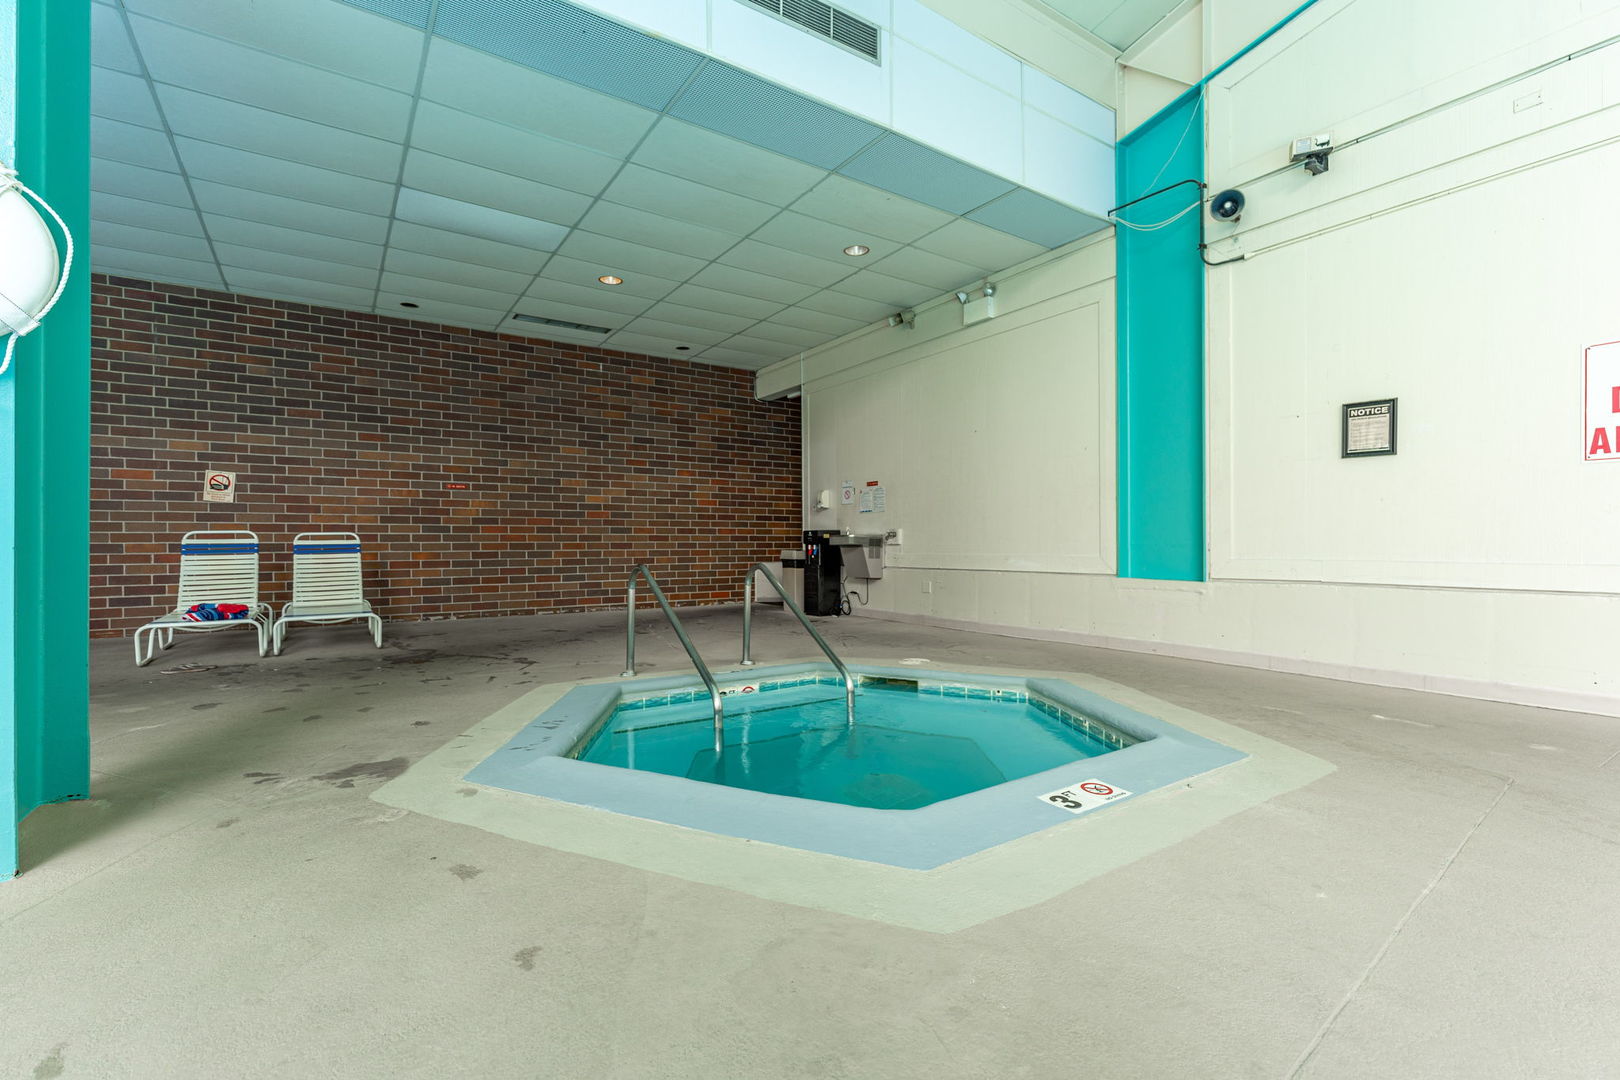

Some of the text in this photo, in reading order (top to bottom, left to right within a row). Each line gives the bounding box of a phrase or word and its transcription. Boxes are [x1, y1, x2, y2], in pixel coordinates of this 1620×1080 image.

[1350, 406, 1389, 417] NOTICE
[1049, 790, 1083, 809] 3 FT
